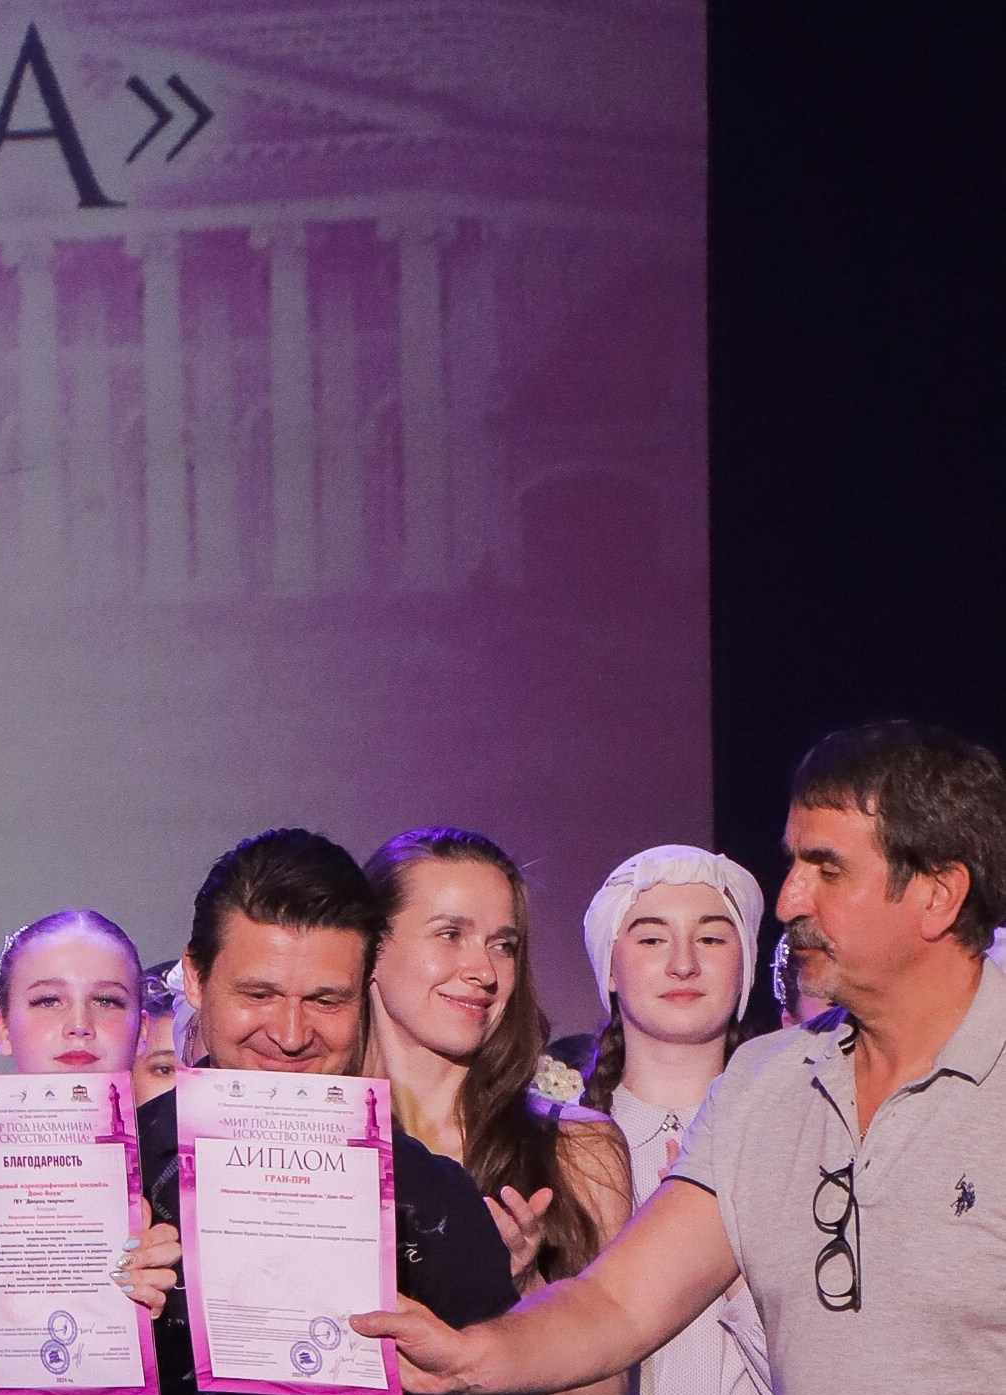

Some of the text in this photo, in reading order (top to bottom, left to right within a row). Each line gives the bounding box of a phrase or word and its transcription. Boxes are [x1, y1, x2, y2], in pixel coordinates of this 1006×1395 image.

[6, 1122, 31, 1132] ПОД
[32, 1121, 92, 1132] НАЗВАНИЕМ
[251, 1118, 276, 1130] ПОД
[279, 1120, 346, 1133] НАЗВАНИЕМ
[233, 1129, 299, 1142] ИСКУССТВО
[3, 1155, 83, 1169] БЛАГОДАРНОСТЬ
[225, 1145, 347, 1173] ДИПЛОМ
[264, 1174, 311, 1184] ГРАН-ПРИ
